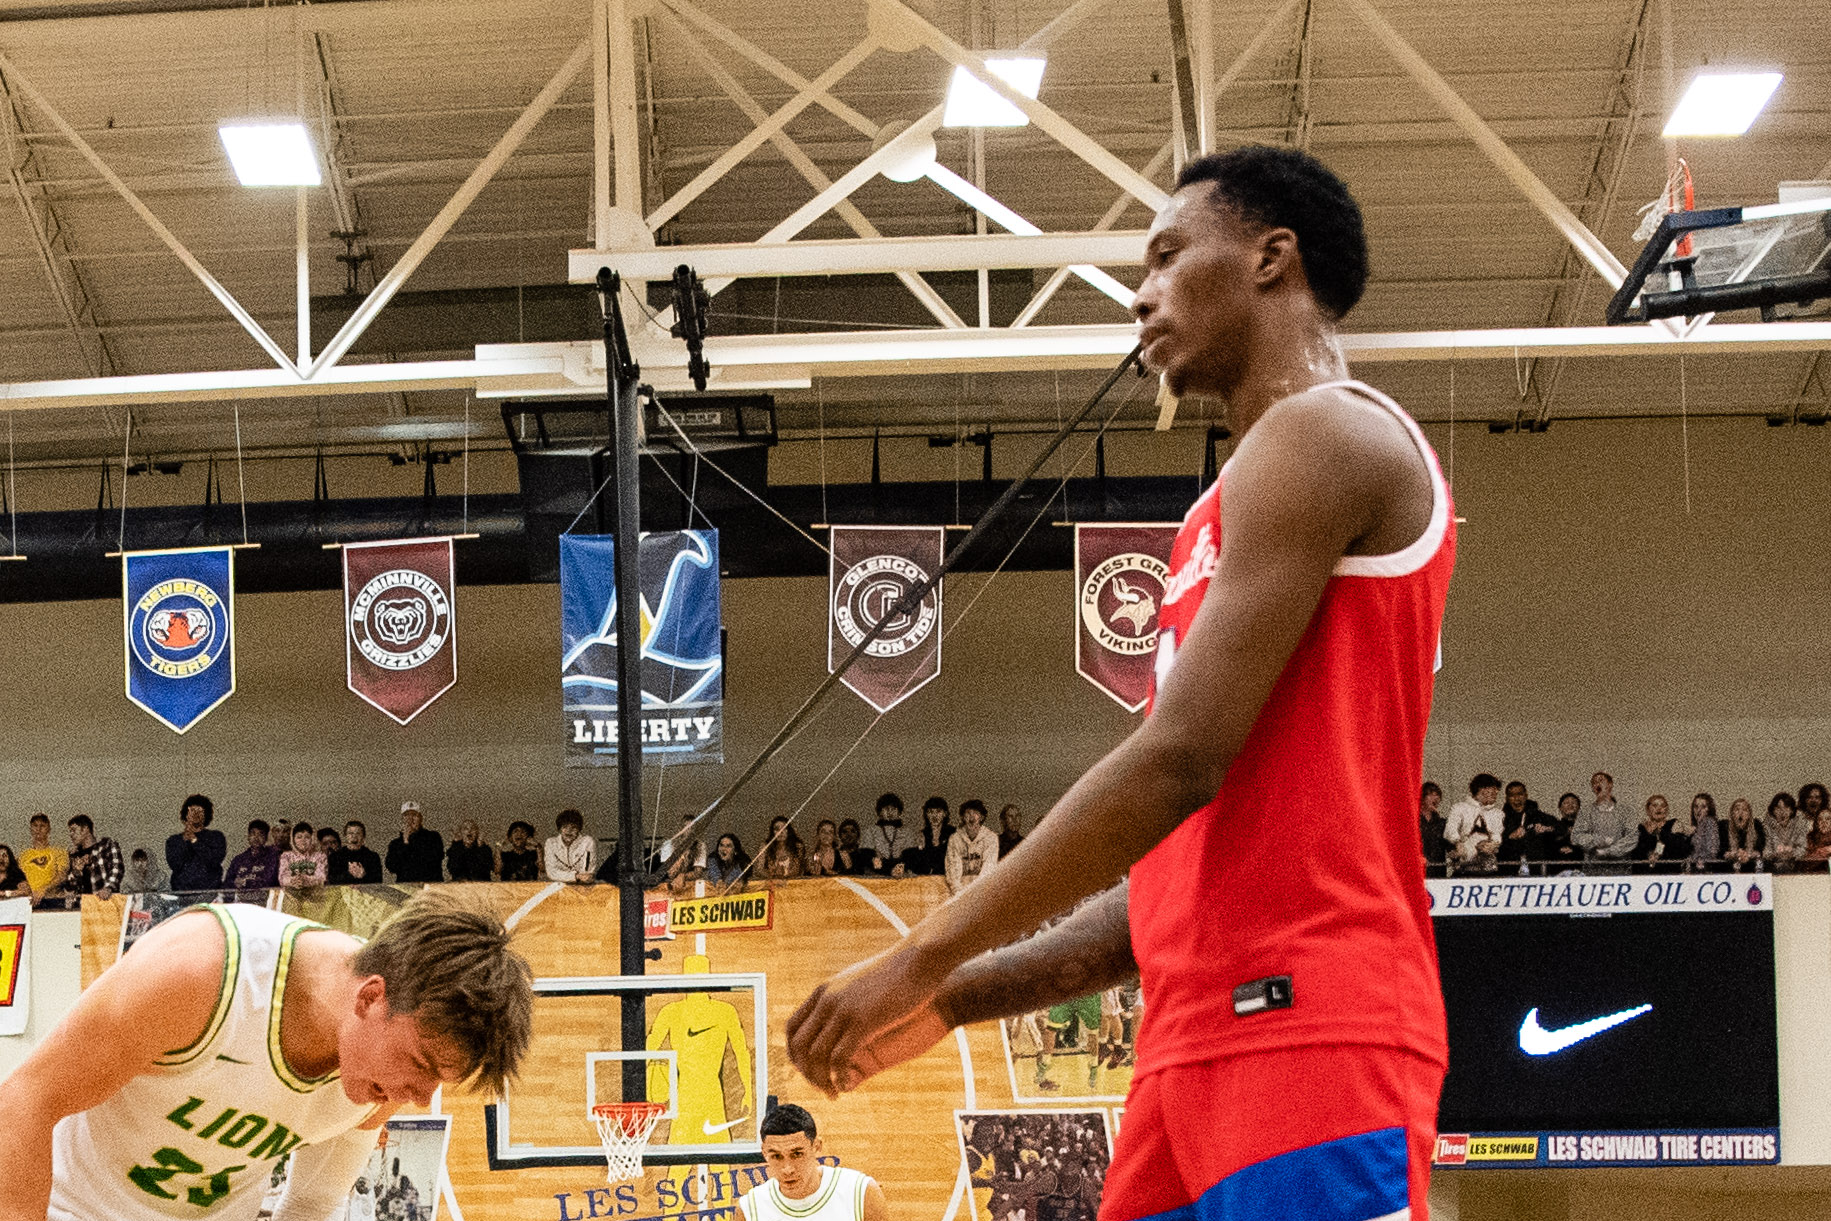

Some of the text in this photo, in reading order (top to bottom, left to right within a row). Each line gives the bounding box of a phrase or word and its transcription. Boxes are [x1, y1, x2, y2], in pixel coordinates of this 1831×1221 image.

[846, 559, 928, 586] GLENCO
[1085, 557, 1135, 605] FOREST
[139, 581, 218, 612] NEWBERG
[353, 572, 447, 622] MCMINNVILLE
[904, 606, 934, 644] TIDE
[360, 633, 443, 668] GRIZZLIES
[1098, 628, 1159, 651] VIKING
[149, 653, 212, 676] TIGERS
[1446, 881, 1737, 909] BRETTHAUER OIL CO.
[644, 908, 667, 928] ires
[671, 898, 766, 925] LES SCHWAB
[166, 1095, 304, 1161] LION
[1439, 1139, 1535, 1158] Tires LES SCHWAB
[1548, 1134, 1776, 1161] LES SCHWAB TIRE CENTERS
